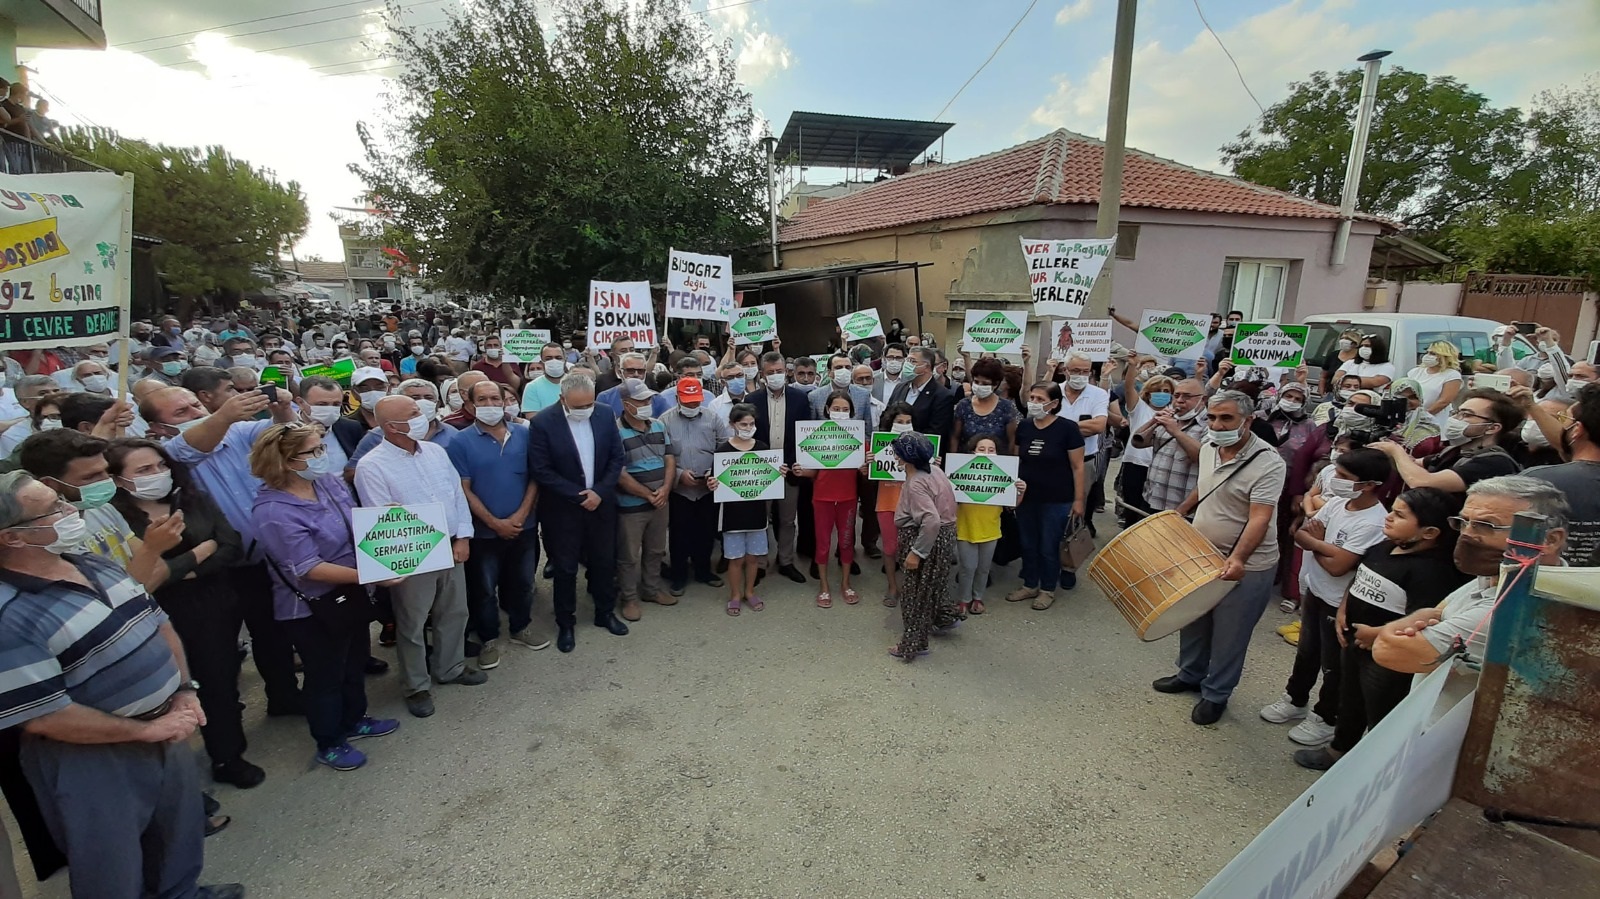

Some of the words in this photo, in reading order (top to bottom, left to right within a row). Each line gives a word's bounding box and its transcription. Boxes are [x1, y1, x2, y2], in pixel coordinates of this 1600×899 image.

[0, 189, 84, 215] yapma
[1025, 243, 1050, 255] VER
[671, 256, 722, 279] BİYOGAZ
[1032, 257, 1079, 270] ELLERE
[49, 273, 102, 305] başına
[594, 286, 631, 309] İŞİN
[668, 290, 716, 312] TEMİZ
[594, 311, 651, 327] BOKUNU
[1148, 315, 1177, 325] ÇAPAKLI
[1177, 318, 1206, 327] TOPRAĞI
[23, 315, 75, 341] ÇEVRE
[967, 326, 1021, 335] KAMULAŞTIRMA
[1154, 326, 1175, 335] TARIM
[1175, 329, 1196, 337] içindir
[1240, 329, 1269, 337] havama
[971, 336, 1015, 344] ZORBALIKTIR
[1151, 336, 1181, 346] SERMAYE
[1181, 339, 1194, 347] için
[1238, 348, 1297, 362] DOKUNMA!
[800, 444, 831, 452] ÇAPAKLIDA
[721, 457, 750, 467] ÇAPAKLI
[751, 455, 780, 465] TOPRAĞI
[969, 462, 994, 471] ACELE
[729, 469, 750, 477] TARIM
[751, 467, 773, 476] içindir
[949, 472, 1013, 484] KAMULAŞTIRMA
[729, 479, 760, 488] SERMAYE
[759, 478, 772, 487] için
[954, 484, 1006, 494] ZORBALIKTIR
[740, 489, 762, 498] DEĞİL!
[377, 512, 402, 524] HALK
[403, 511, 419, 523] için
[365, 524, 436, 541] KAMULAŞTIRMA
[374, 542, 414, 557] SERMAYE
[415, 540, 432, 553] için
[390, 556, 420, 572] DEĞİL!
